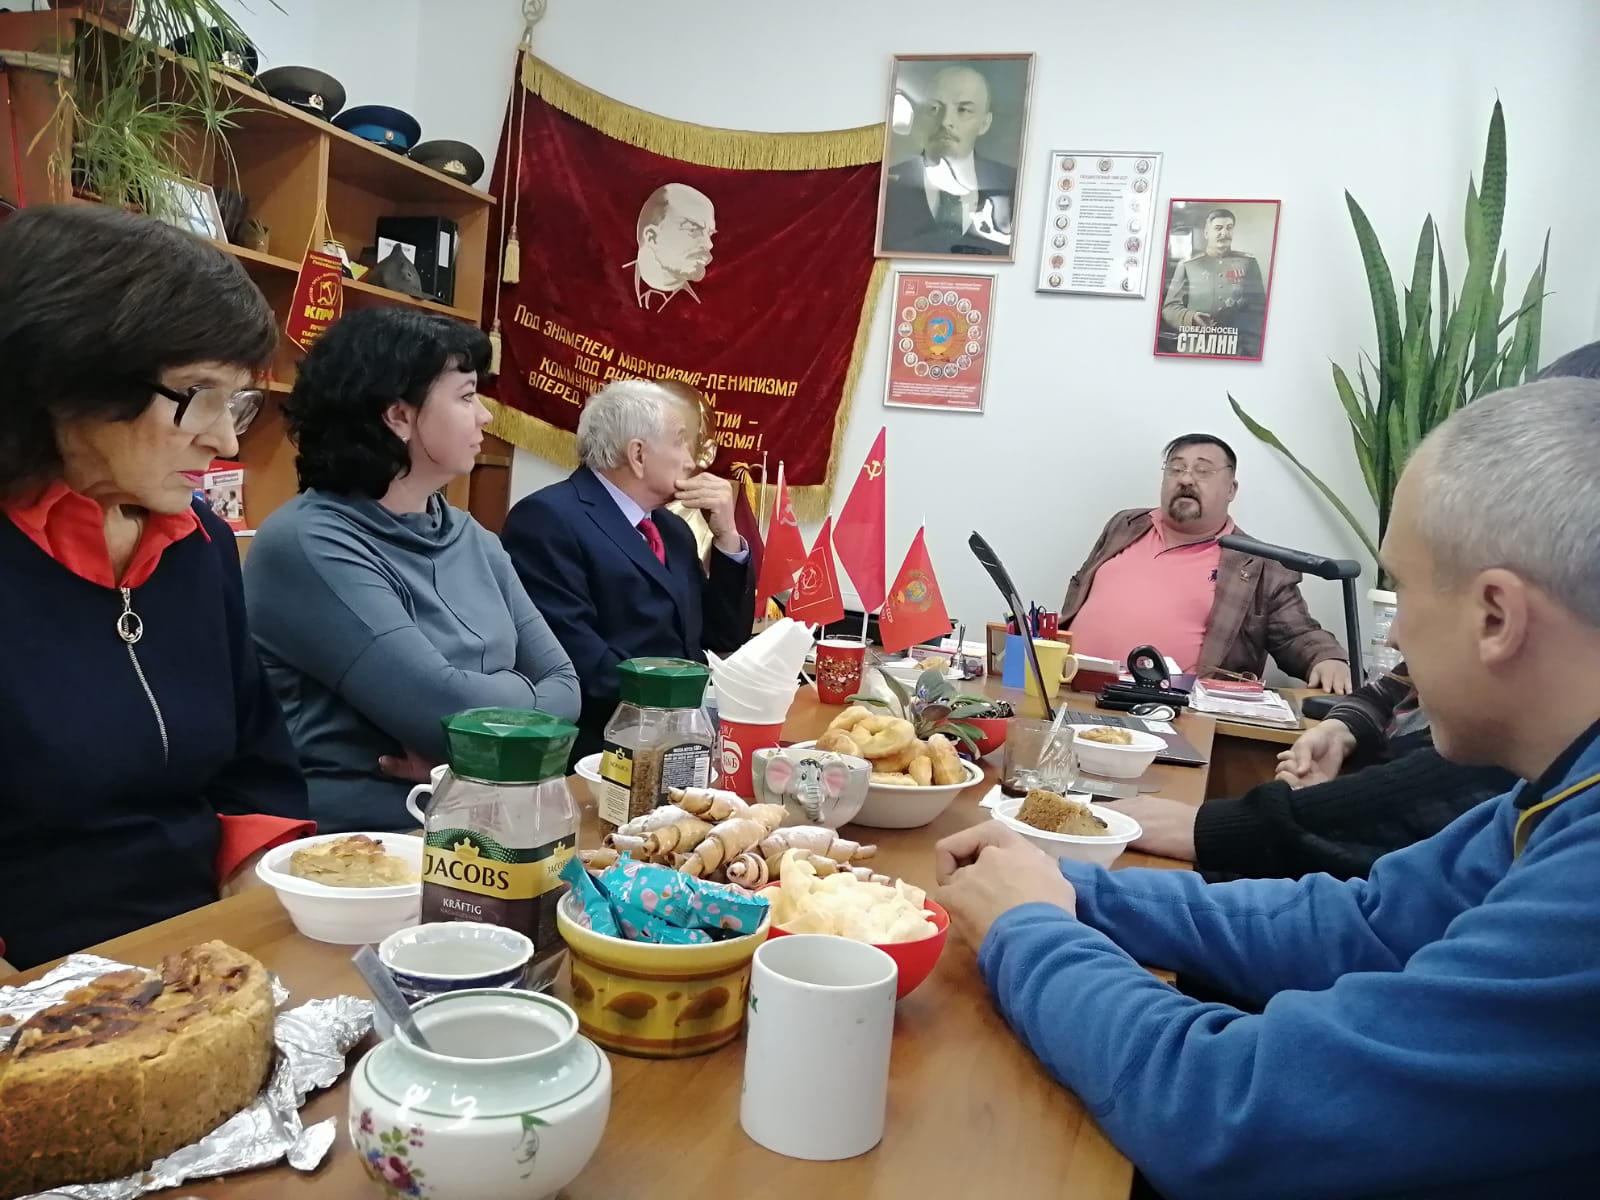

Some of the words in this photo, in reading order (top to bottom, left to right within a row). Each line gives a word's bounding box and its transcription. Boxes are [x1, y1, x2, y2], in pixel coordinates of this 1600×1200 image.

[514, 304, 541, 331] Под
[543, 320, 615, 362] ЗНАМЕНЕМ
[1178, 325, 1239, 335] ПОБЕДОНОСЕЦ
[1176, 332, 1239, 355] СТАЛИН
[574, 354, 601, 376] ПОД
[714, 410, 742, 429] ТИИ
[423, 854, 510, 890] JACOBS
[442, 897, 483, 915] KRÄFTIG
